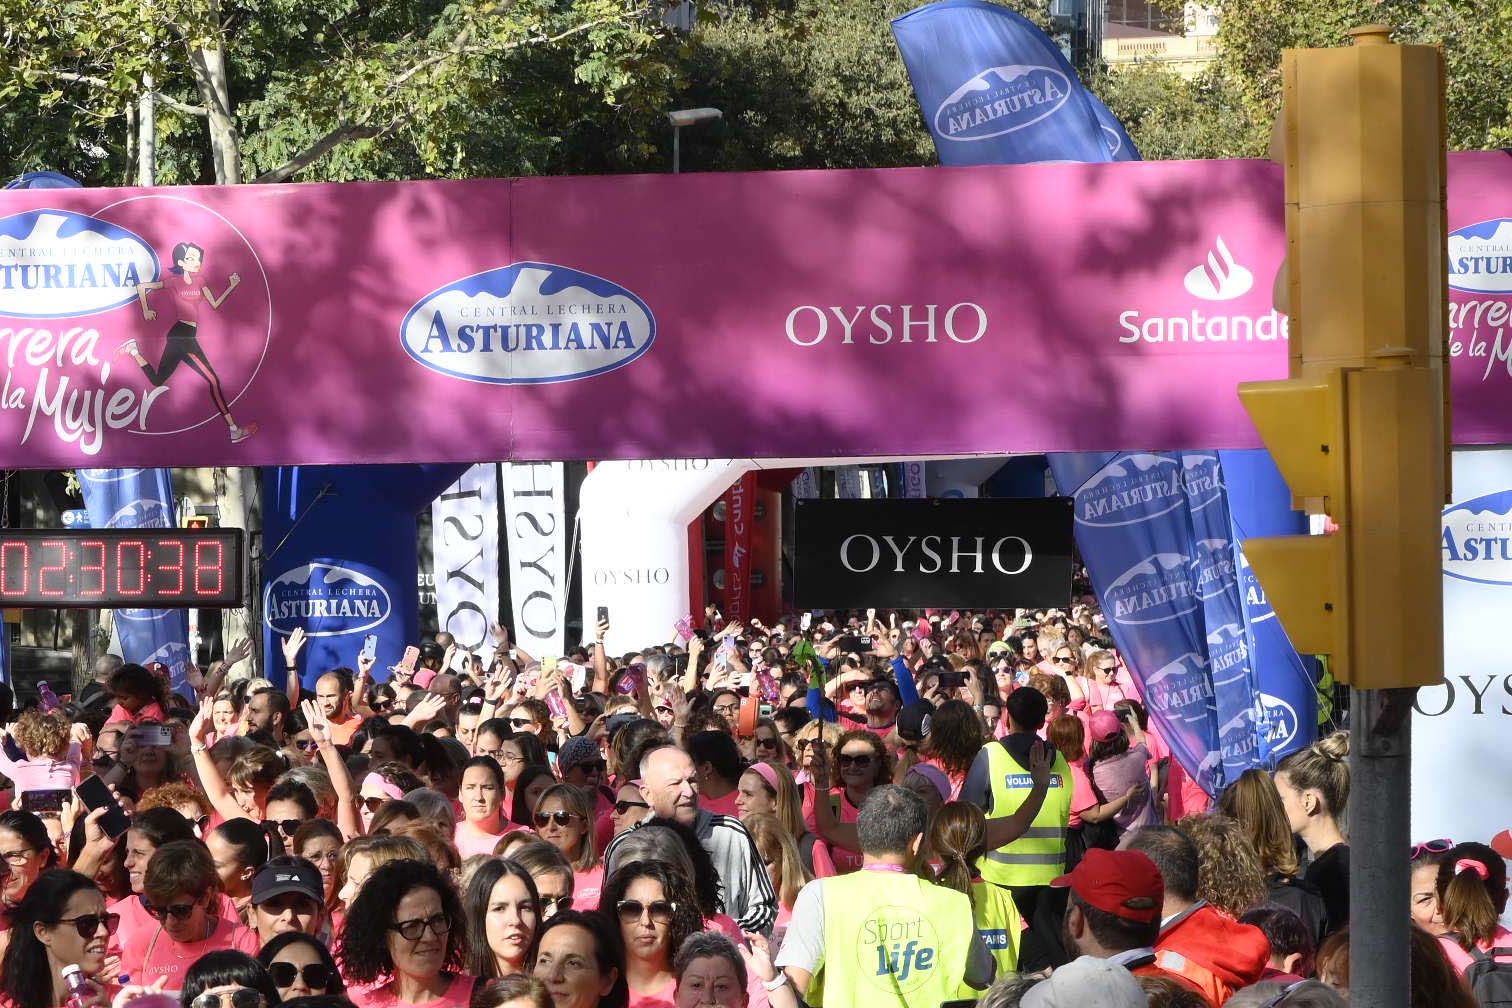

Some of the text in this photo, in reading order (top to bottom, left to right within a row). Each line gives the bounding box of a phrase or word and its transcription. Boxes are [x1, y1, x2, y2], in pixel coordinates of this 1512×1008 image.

[460, 303, 629, 317] CENTRAL LECHERA
[785, 302, 988, 347] OYSHO
[420, 309, 637, 354] ASTURIANA
[1469, 328, 1487, 357] la
[0, 372, 26, 410] la
[21, 363, 170, 455] Mujer
[0, 540, 223, 595] 02:30:38
[840, 534, 1034, 575] OYSHO
[281, 587, 377, 597] CENTRAL LECHERA
[593, 567, 670, 585] OYSHO
[270, 594, 382, 620] ASTURIANA
[863, 918, 923, 945] Sport
[875, 941, 934, 983] life
